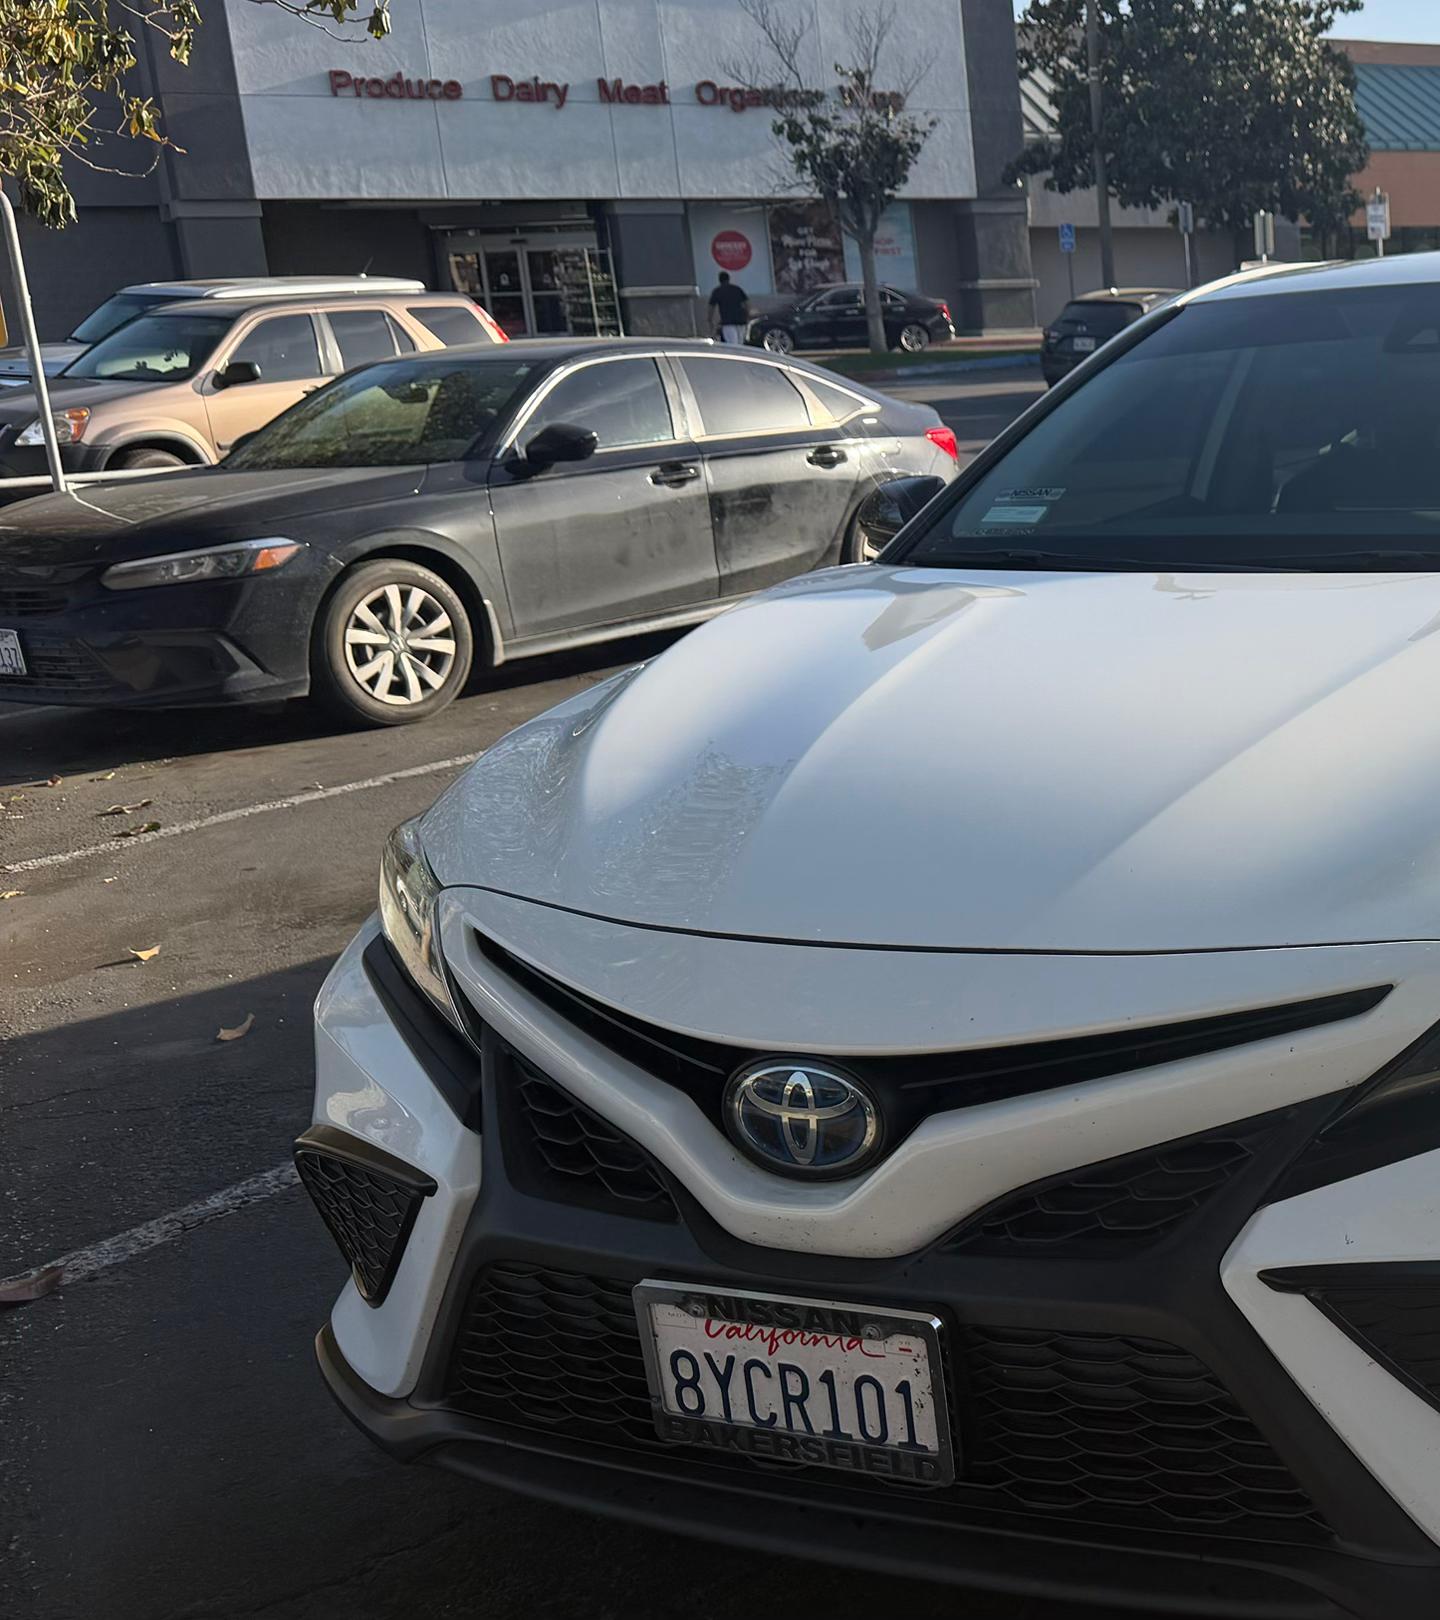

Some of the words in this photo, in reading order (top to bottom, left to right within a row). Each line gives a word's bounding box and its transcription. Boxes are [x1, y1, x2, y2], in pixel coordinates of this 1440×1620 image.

[328, 69, 463, 99] Produce
[491, 74, 568, 109] Dairy
[597, 77, 670, 105] Meat
[705, 1295, 861, 1335] NISSAN
[704, 1317, 886, 1357] California
[669, 1349, 929, 1452] 8YCR101
[668, 1420, 942, 1481] BAKERSFIELD
